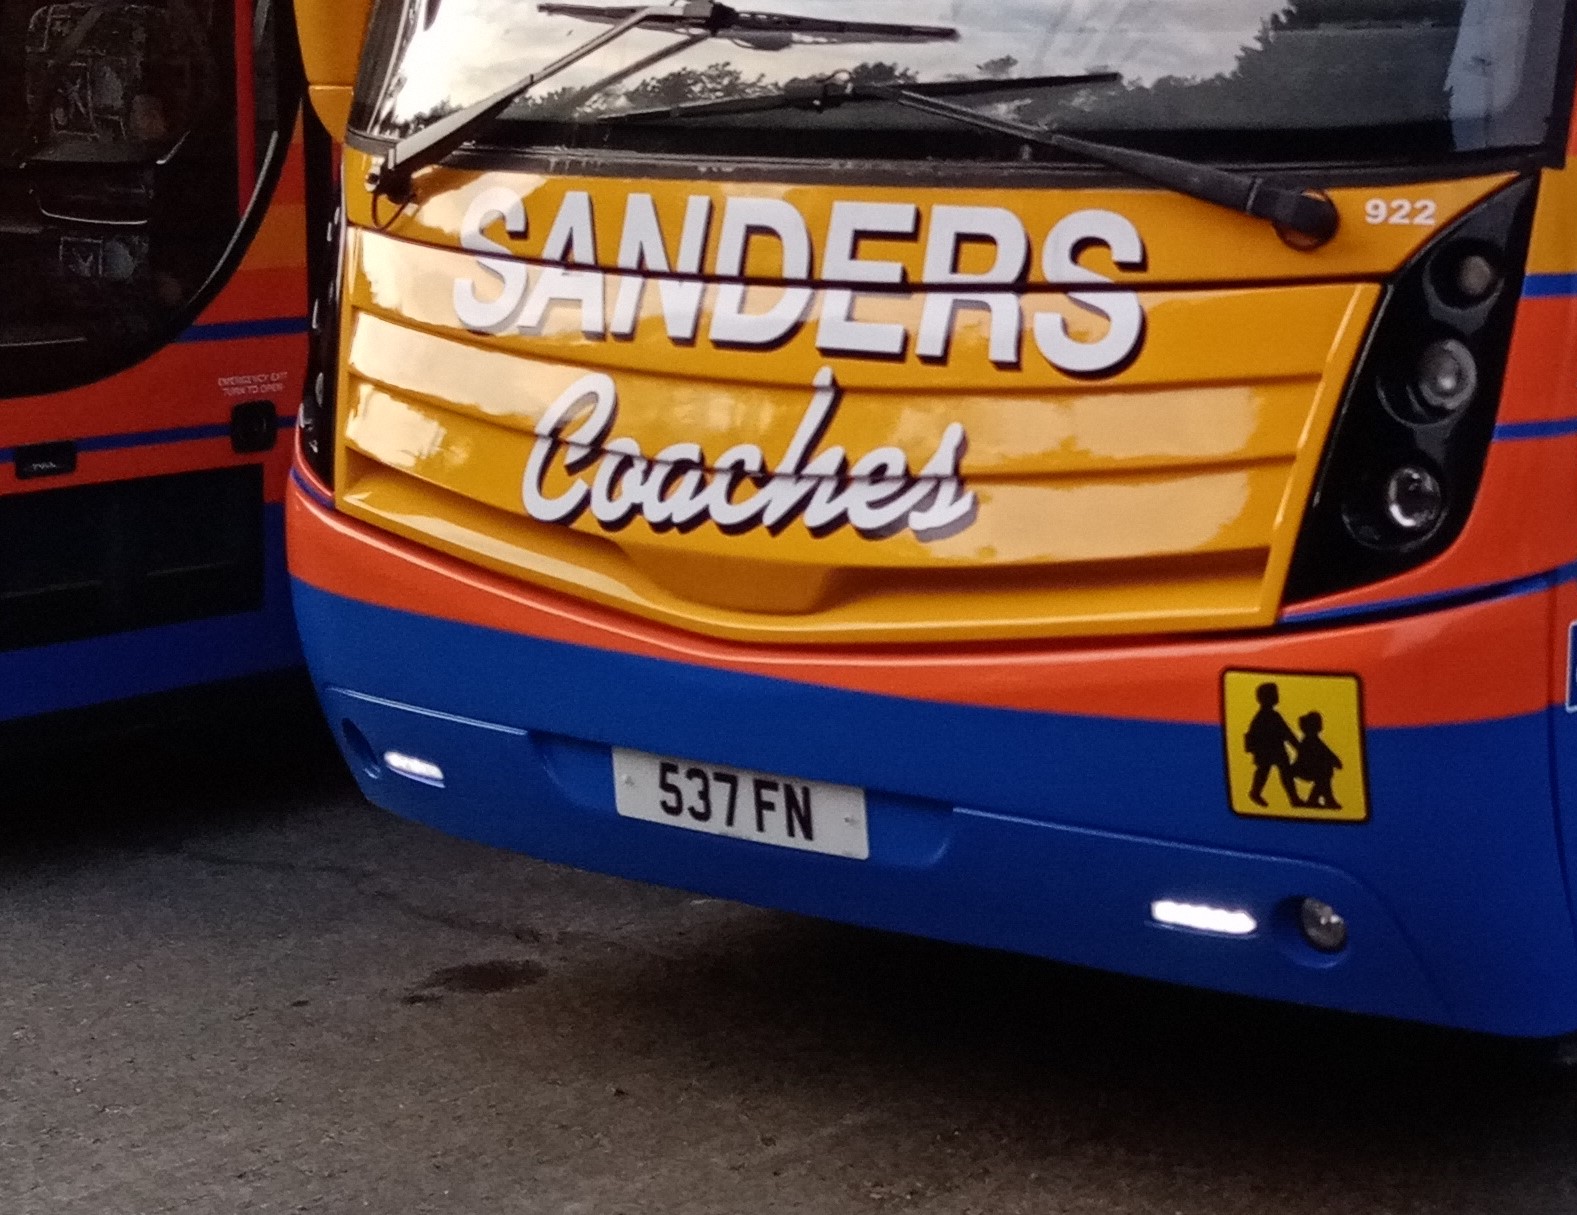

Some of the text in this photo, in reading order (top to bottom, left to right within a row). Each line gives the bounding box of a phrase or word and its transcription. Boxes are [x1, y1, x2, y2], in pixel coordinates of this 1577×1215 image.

[1364, 197, 1438, 225] 922
[452, 186, 1146, 374] SANDERS
[521, 366, 979, 536] Coaches
[658, 761, 815, 842] 537 FN
